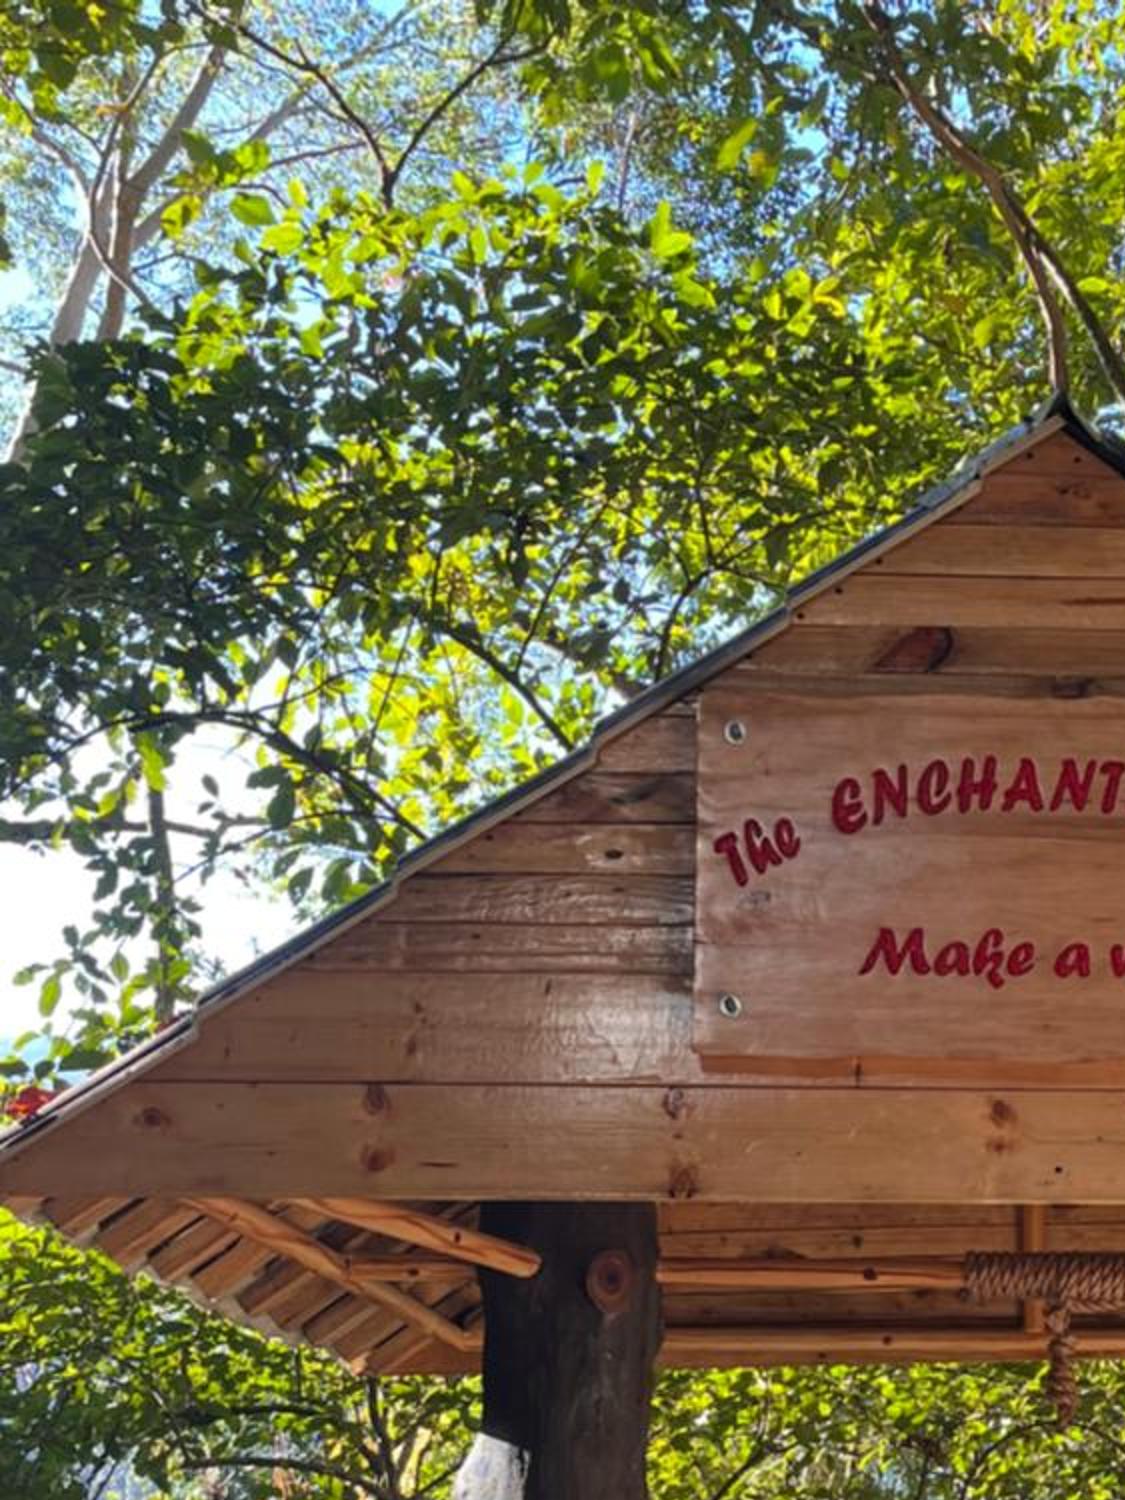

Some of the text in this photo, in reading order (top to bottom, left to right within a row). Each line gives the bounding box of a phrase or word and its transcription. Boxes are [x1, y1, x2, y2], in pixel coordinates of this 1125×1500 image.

[713, 816, 802, 887] The
[859, 926, 1036, 989] Make
[1053, 942, 1092, 979] a
